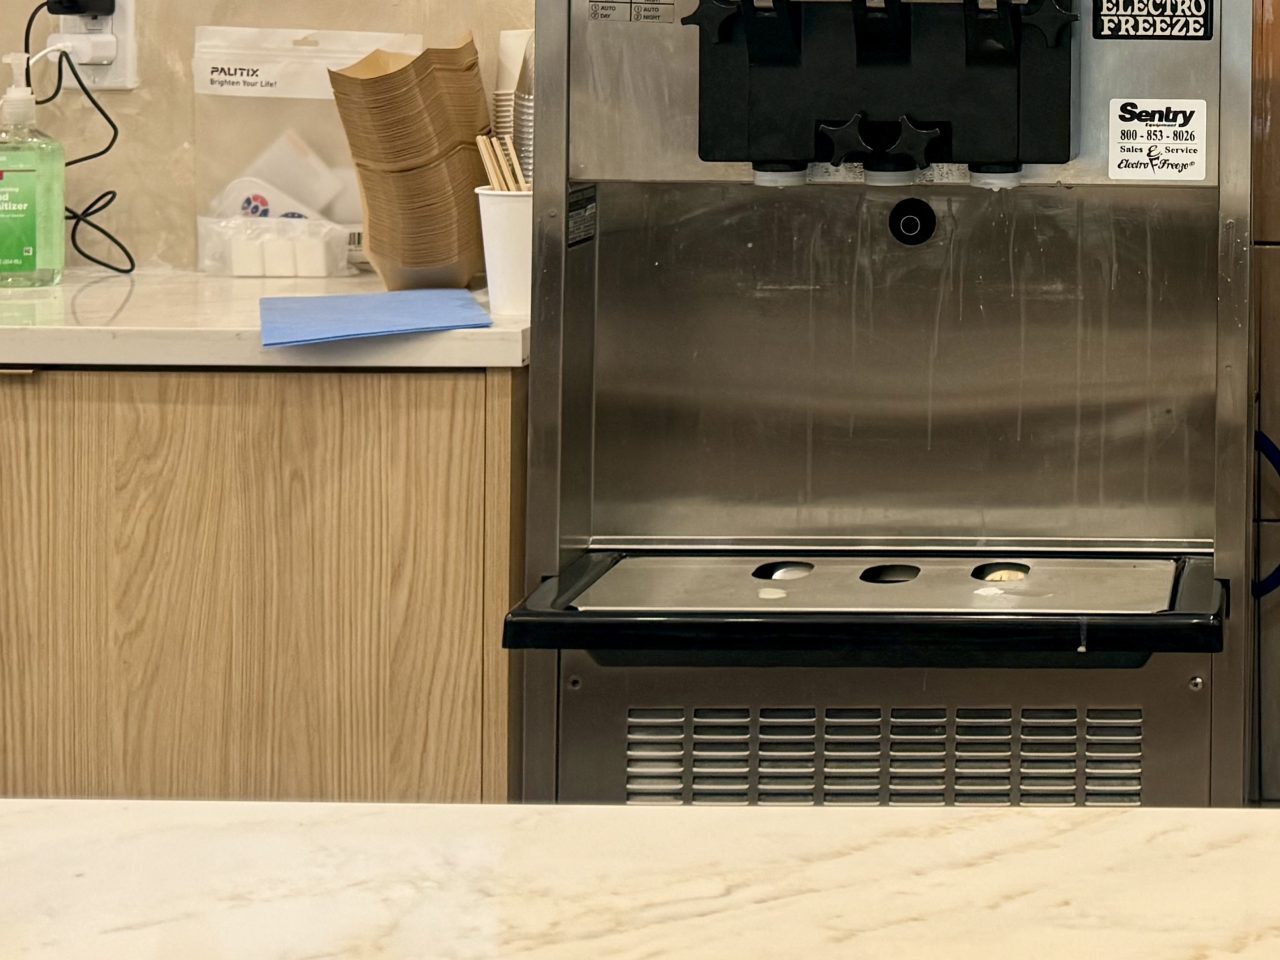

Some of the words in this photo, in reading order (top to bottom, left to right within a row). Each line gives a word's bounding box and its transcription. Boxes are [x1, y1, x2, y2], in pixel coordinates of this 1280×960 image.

[1101, 16, 1204, 36] FREEZE
[1118, 102, 1195, 127] Sentry
[1120, 129, 1138, 141] 800
[1146, 130, 1163, 141] 853
[1172, 130, 1196, 141] 8026
